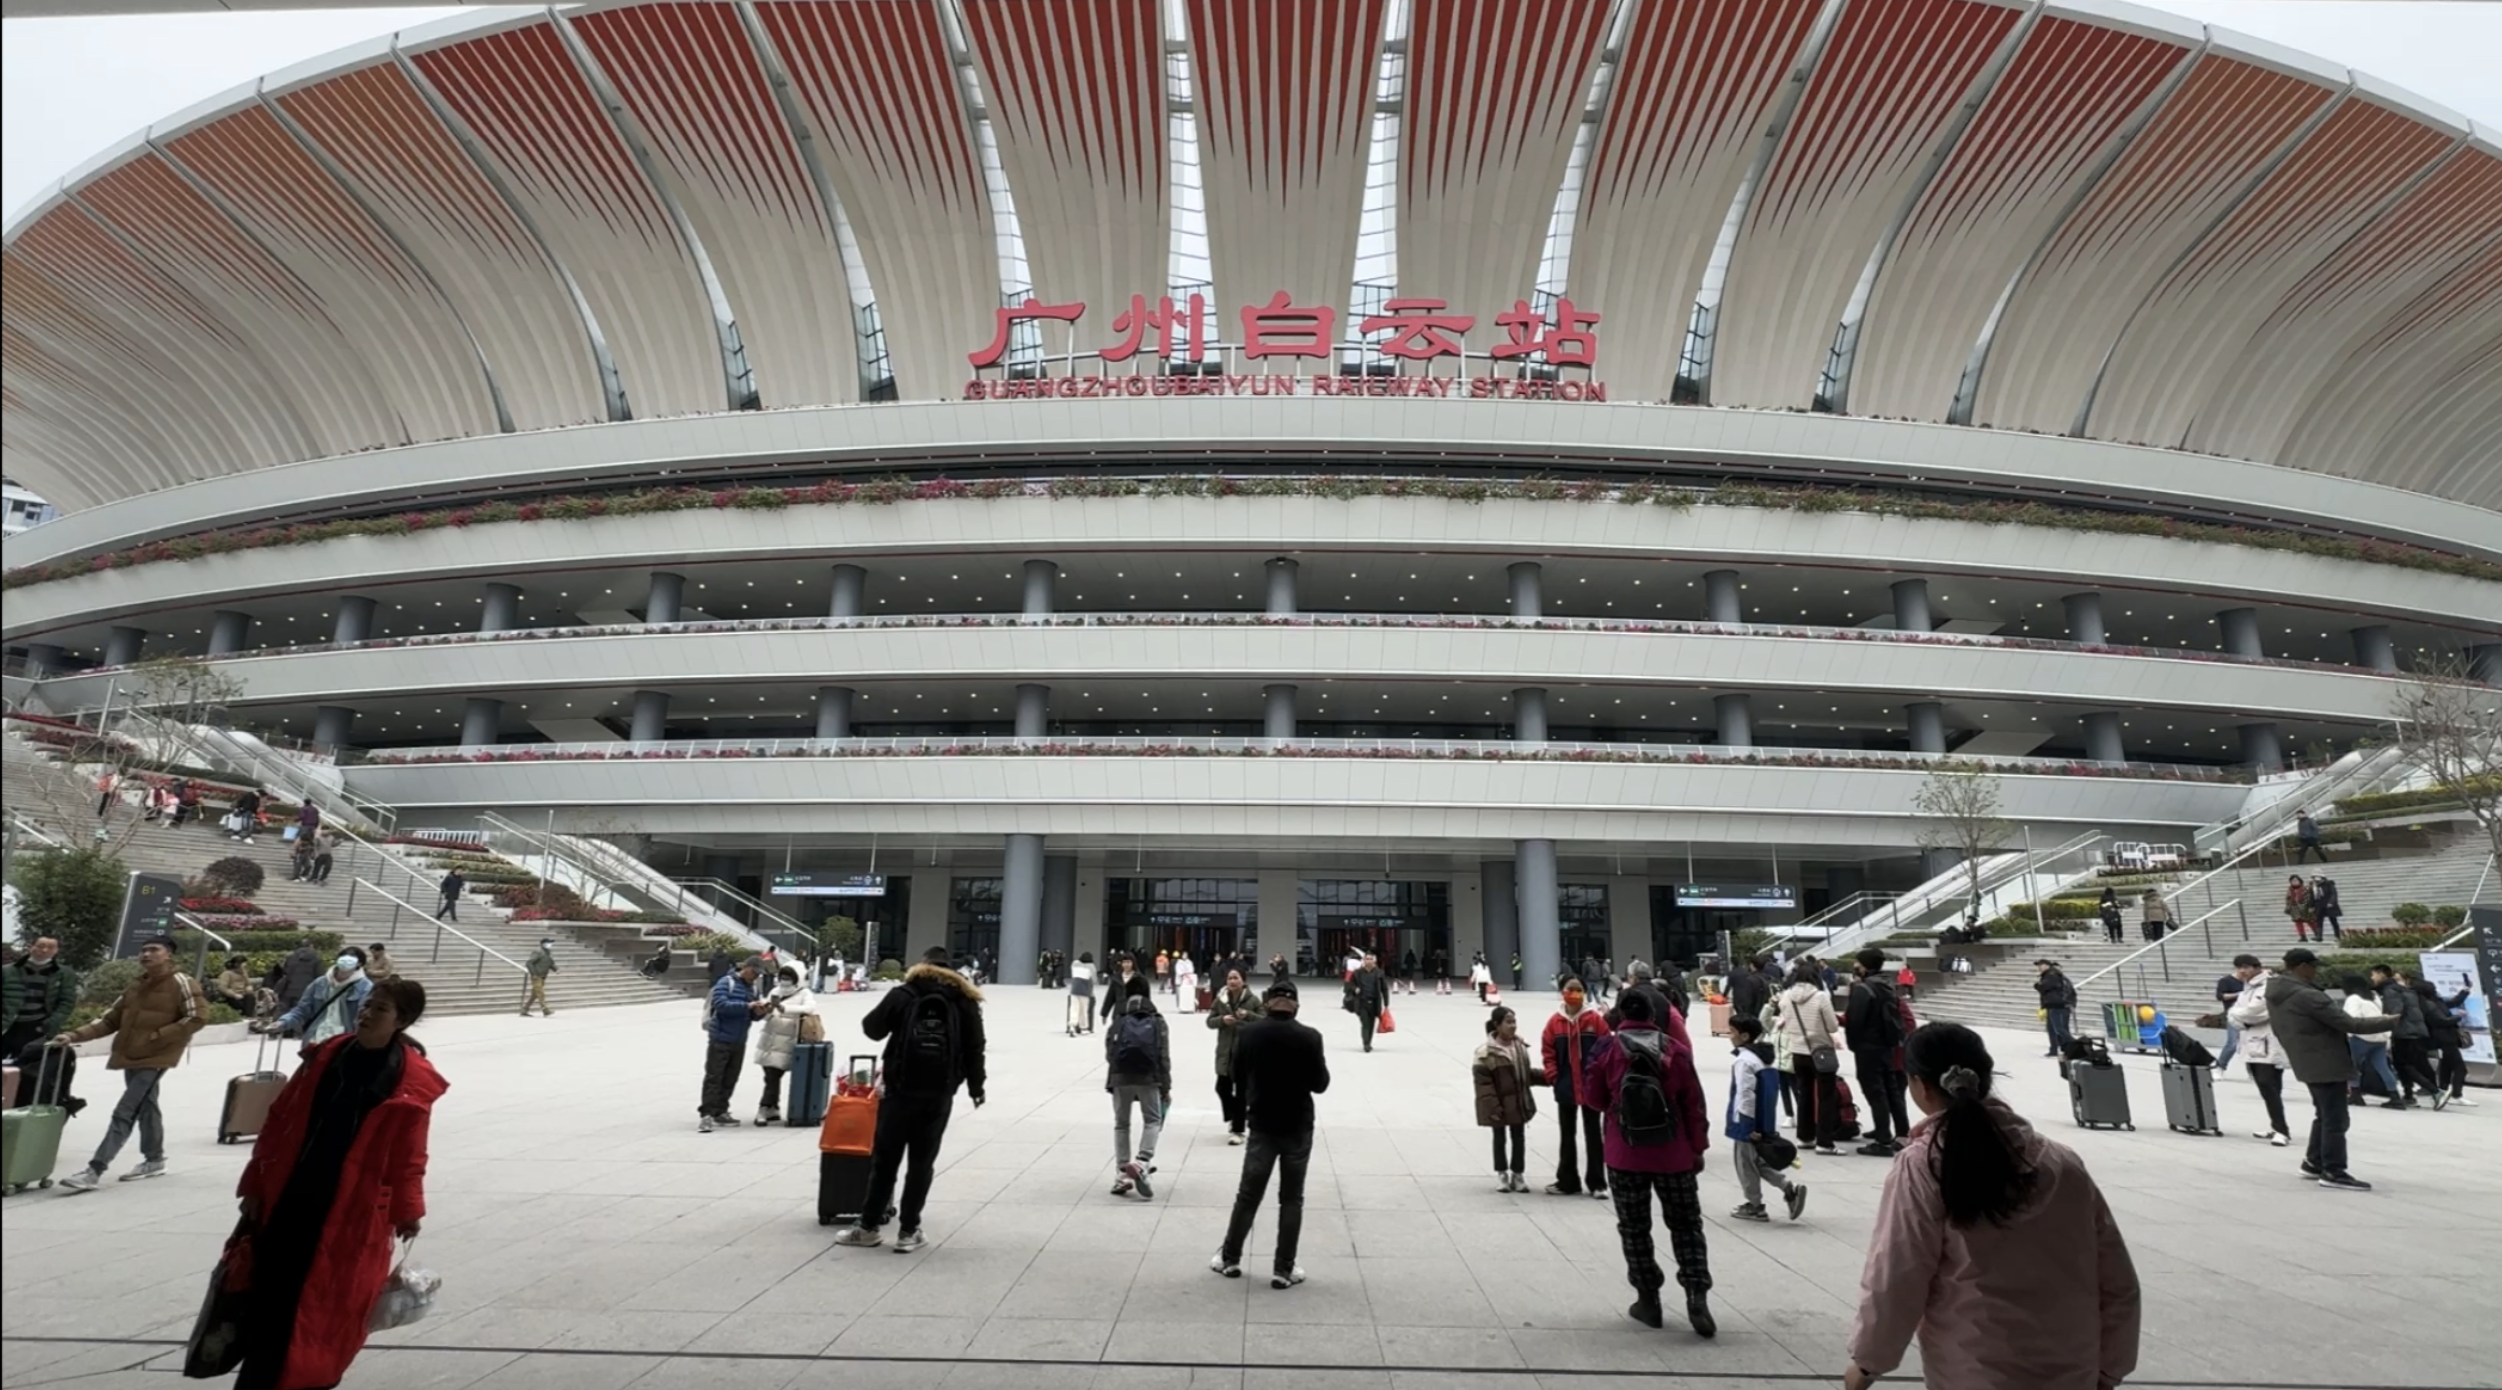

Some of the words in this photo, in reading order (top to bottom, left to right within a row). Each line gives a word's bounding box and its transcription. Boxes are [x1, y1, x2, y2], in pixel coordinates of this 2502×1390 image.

[968, 291, 1600, 367] 广州白云站
[964, 375, 1294, 400] GUANGZHOUBAIYUN
[1312, 375, 1454, 398] RAILWAY
[1471, 377, 1607, 402] STATION
